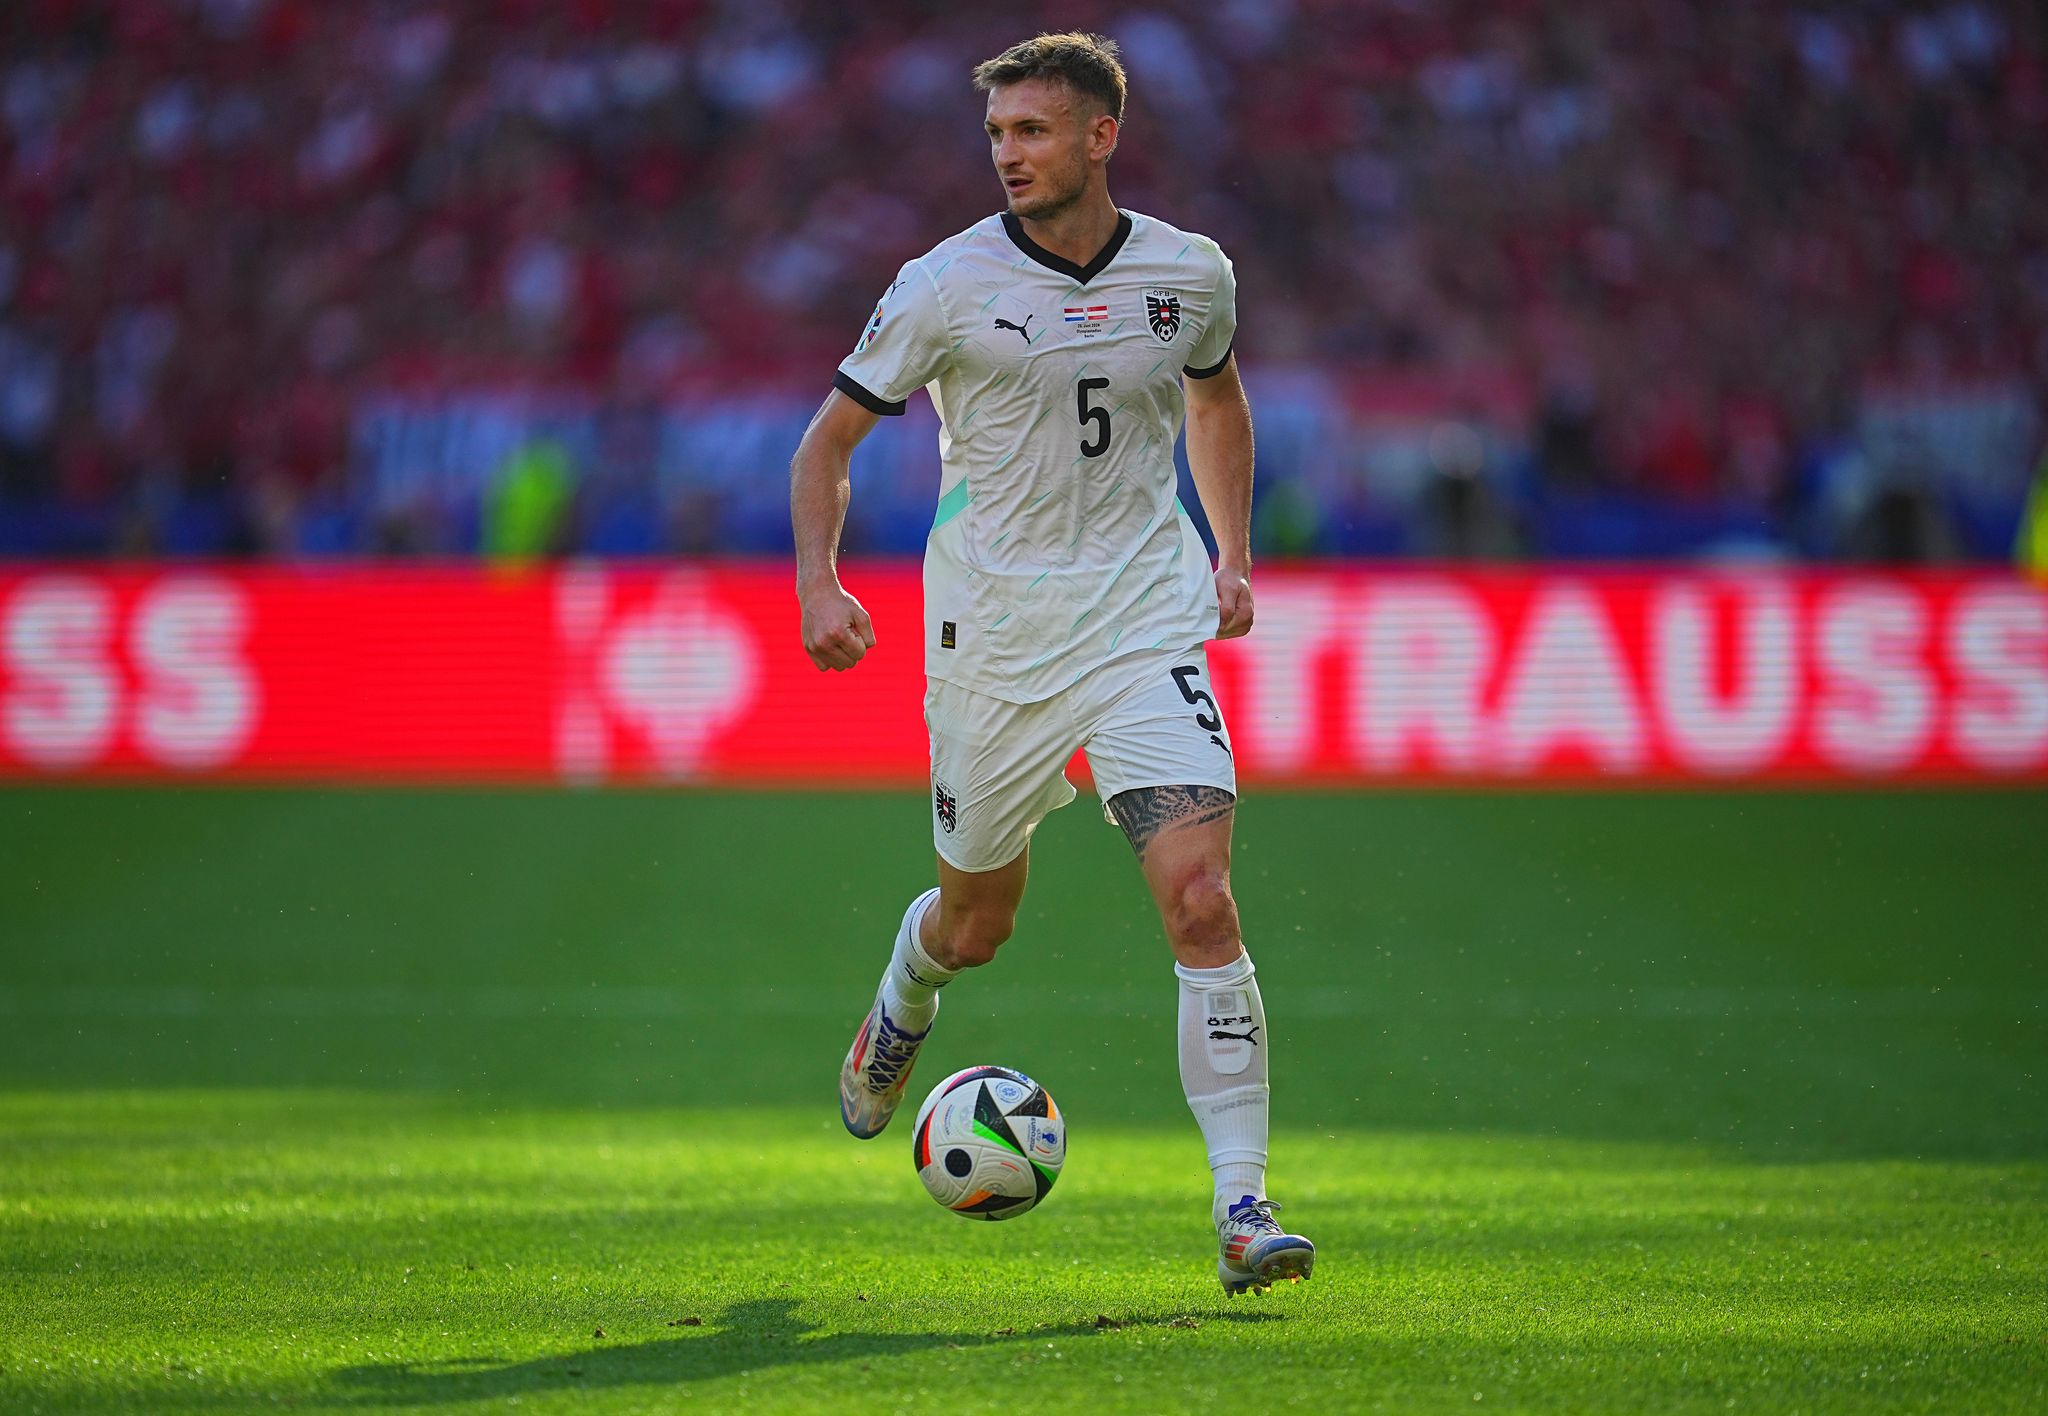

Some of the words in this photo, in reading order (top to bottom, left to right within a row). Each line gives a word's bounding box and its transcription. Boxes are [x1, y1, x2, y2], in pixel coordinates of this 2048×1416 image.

[1078, 378, 1110, 458] 5
[1171, 666, 1222, 732] 5
[1207, 1015, 1252, 1026] ÖFB
